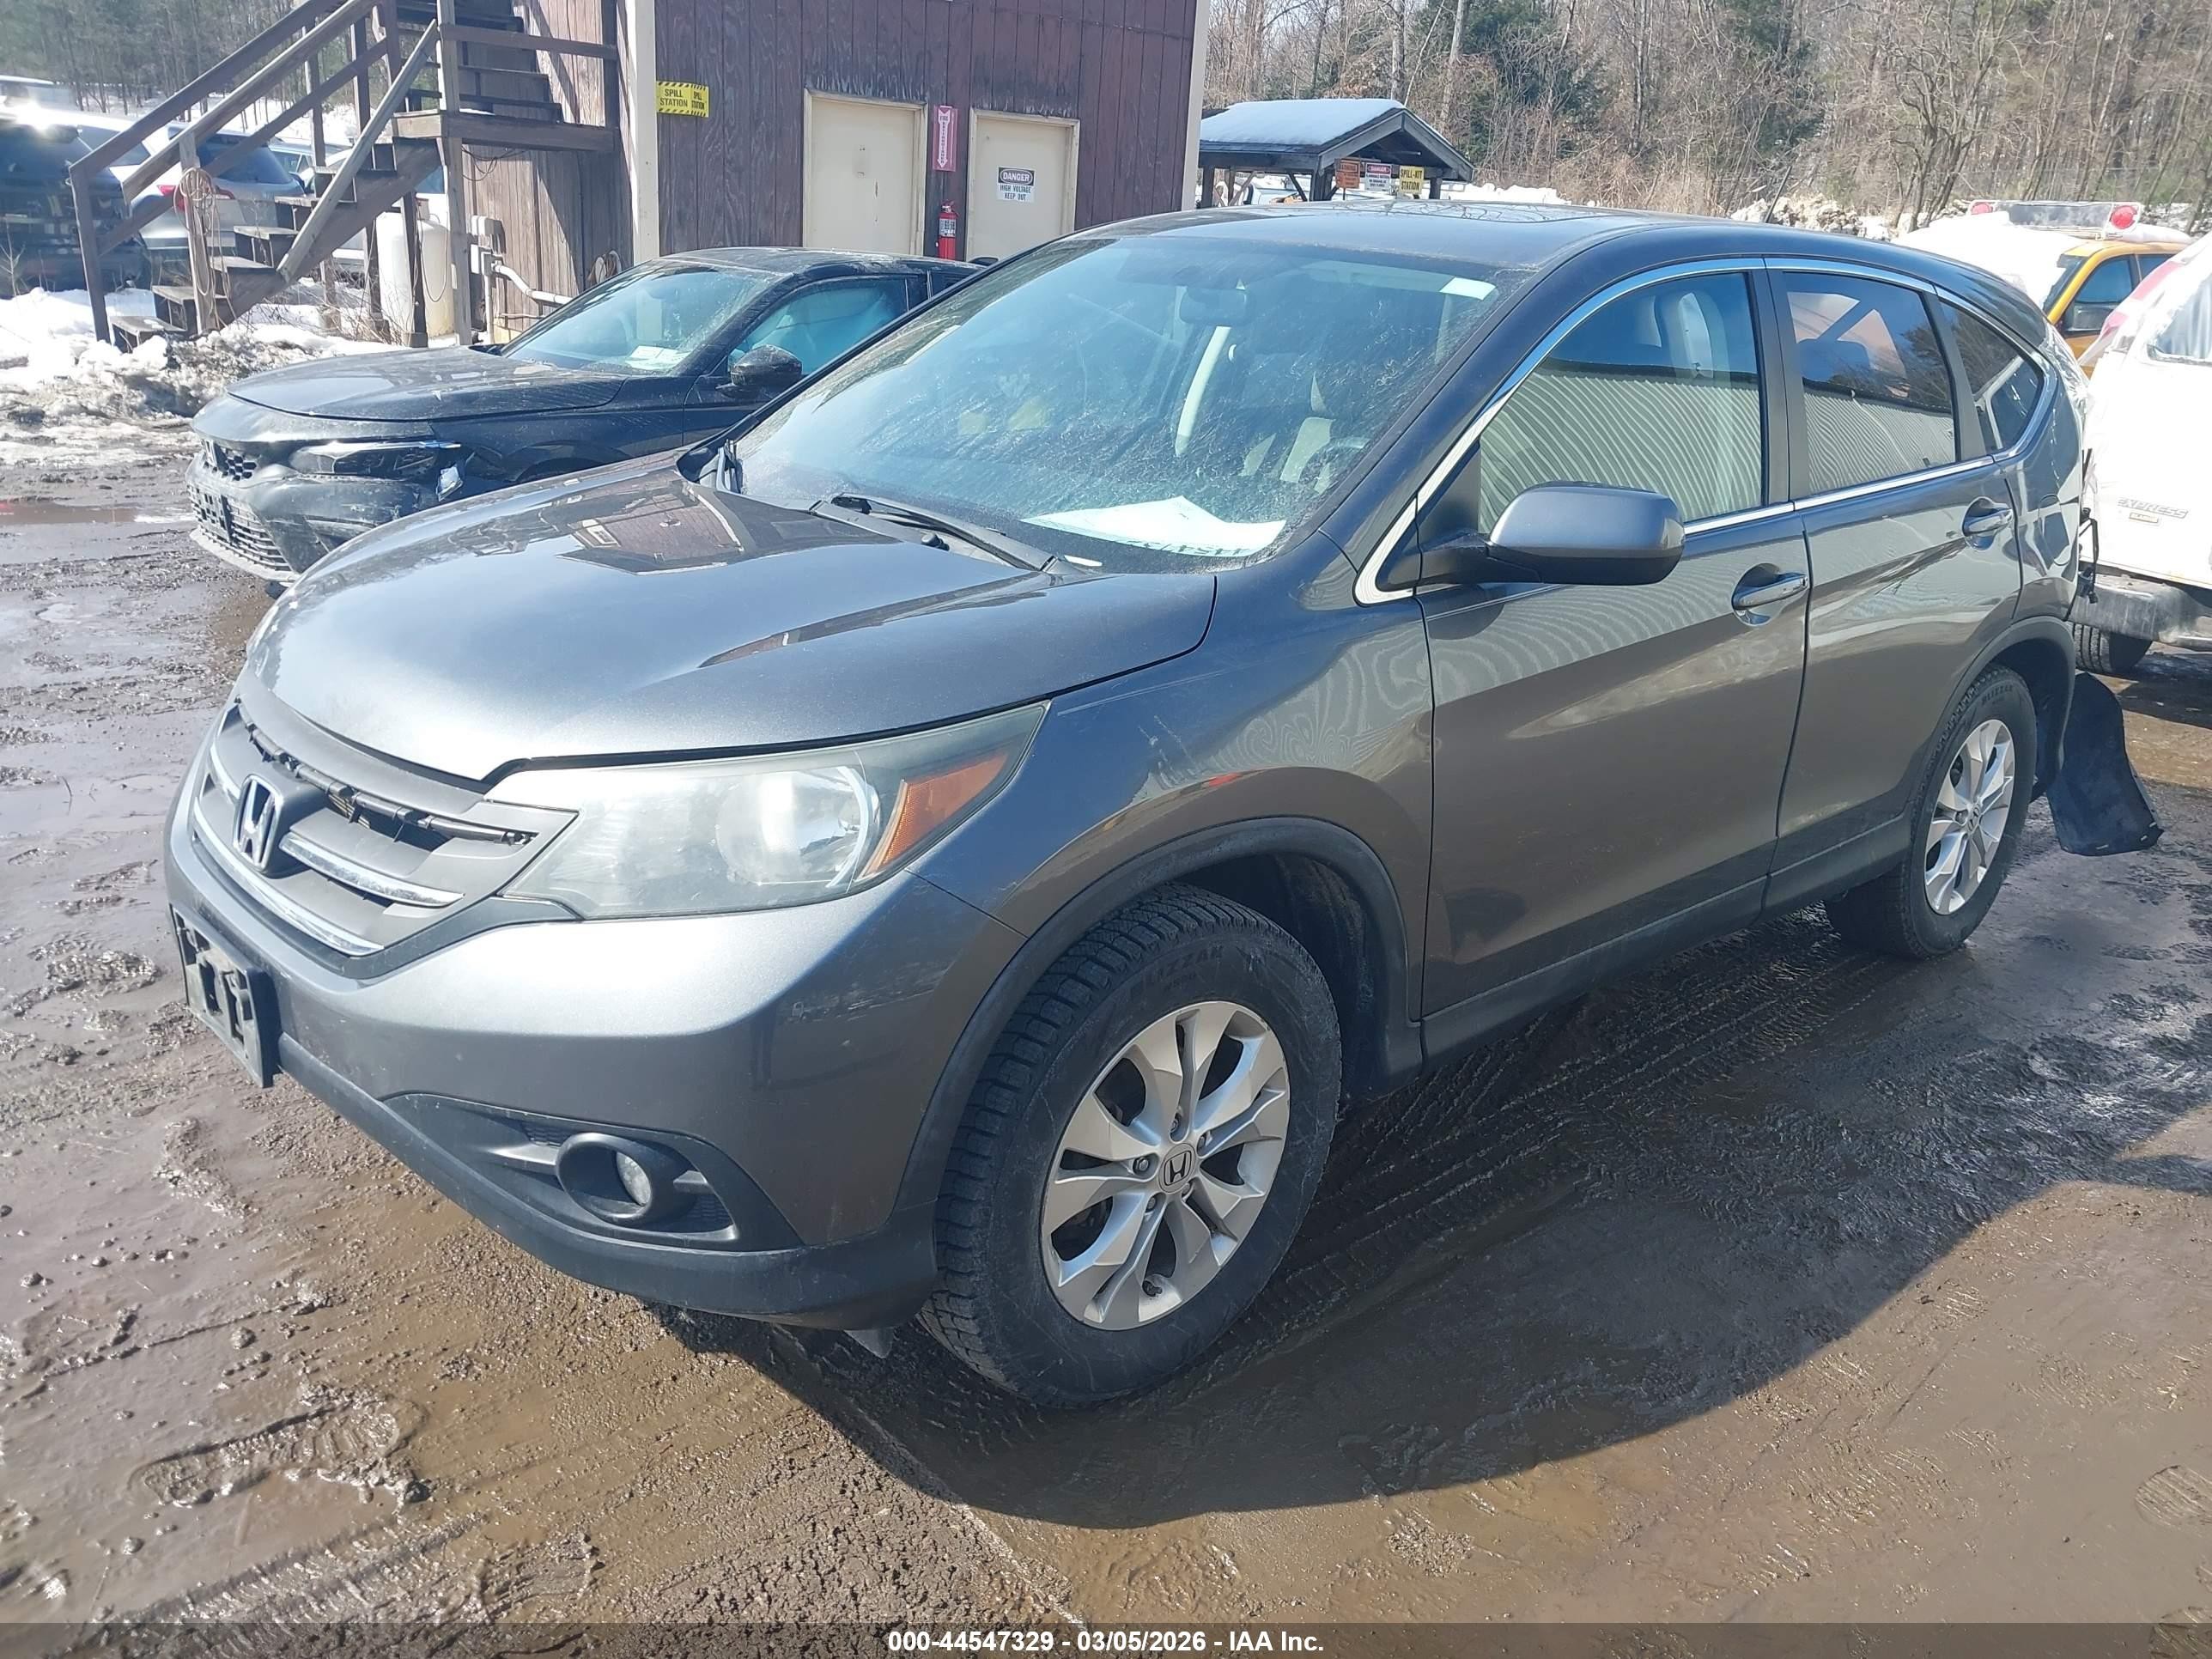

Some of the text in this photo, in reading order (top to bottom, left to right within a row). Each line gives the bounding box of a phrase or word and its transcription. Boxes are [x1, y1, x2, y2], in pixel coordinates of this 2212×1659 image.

[665, 88, 684, 98] SPILL
[659, 97, 688, 107] STATION
[1003, 172, 1030, 182] DANGER
[1012, 185, 1031, 194] VOLTAGE
[1401, 180, 1420, 191] STATION
[2117, 498, 2189, 520] EXPRESS
